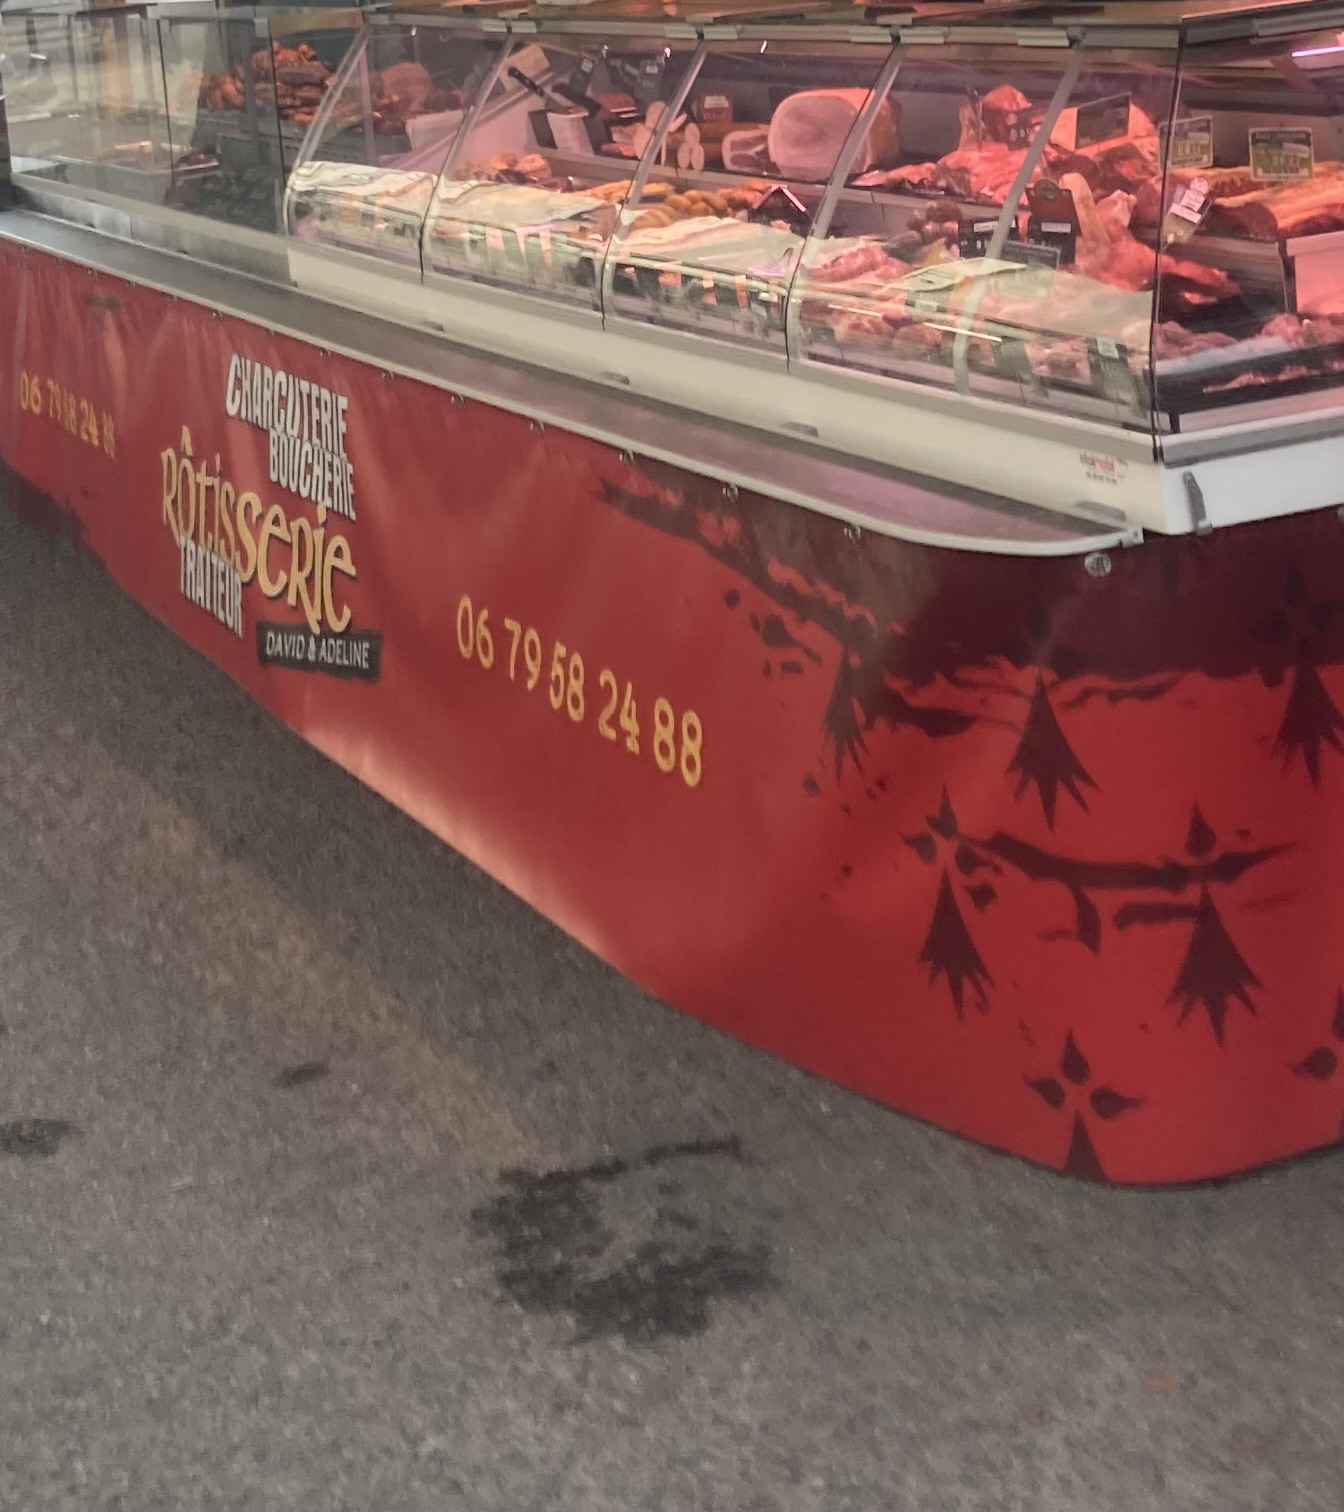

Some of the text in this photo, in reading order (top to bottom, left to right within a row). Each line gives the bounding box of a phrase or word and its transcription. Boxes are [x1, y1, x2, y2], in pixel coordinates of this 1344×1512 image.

[20, 370, 42, 415] 06
[80, 397, 99, 446] 24
[226, 354, 349, 458] CHARCUTERIE
[269, 426, 356, 520] BOUCHERIE
[180, 538, 243, 637] TRAITEUR
[266, 631, 370, 668] DAVID & ADELINE
[457, 594, 703, 787] 06 79 58 24 88
